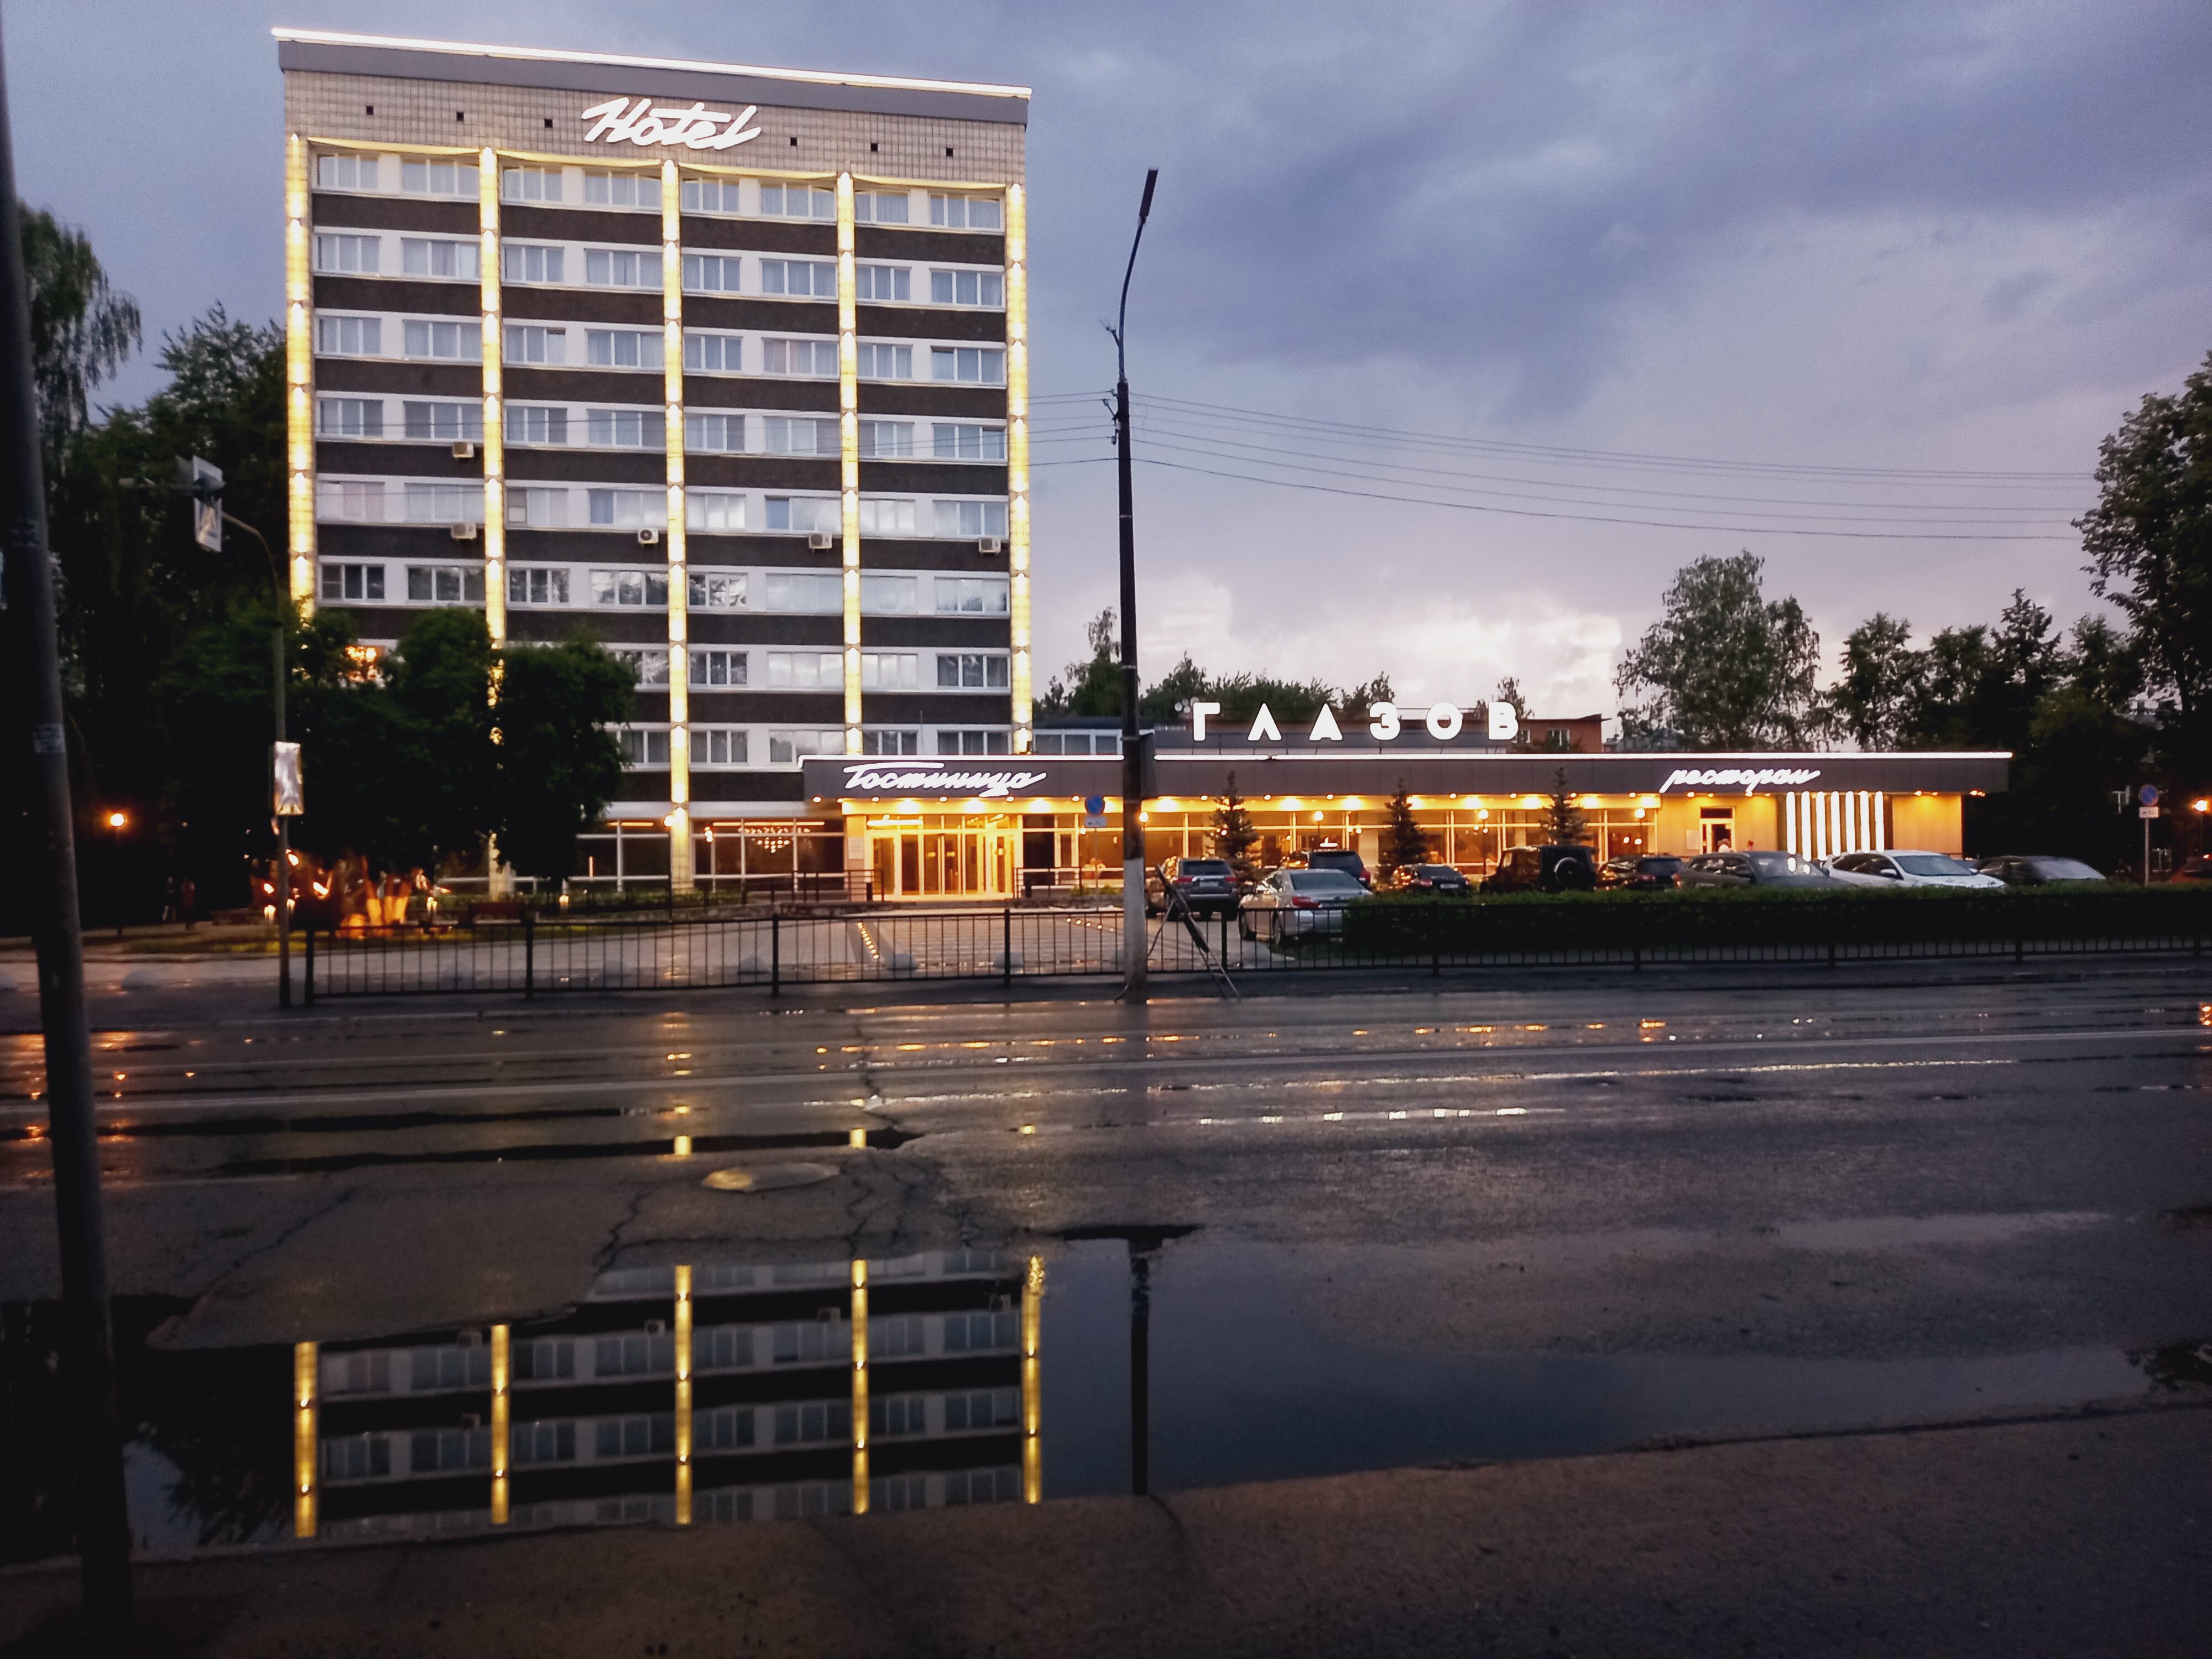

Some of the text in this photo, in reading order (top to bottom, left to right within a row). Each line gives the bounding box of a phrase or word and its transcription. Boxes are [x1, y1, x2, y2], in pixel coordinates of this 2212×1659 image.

[581, 97, 761, 150] Hotel
[1193, 702, 1519, 741] ГЛАЗОВ
[843, 761, 1047, 797] Гостиница
[1659, 769, 1820, 793] ресторан
